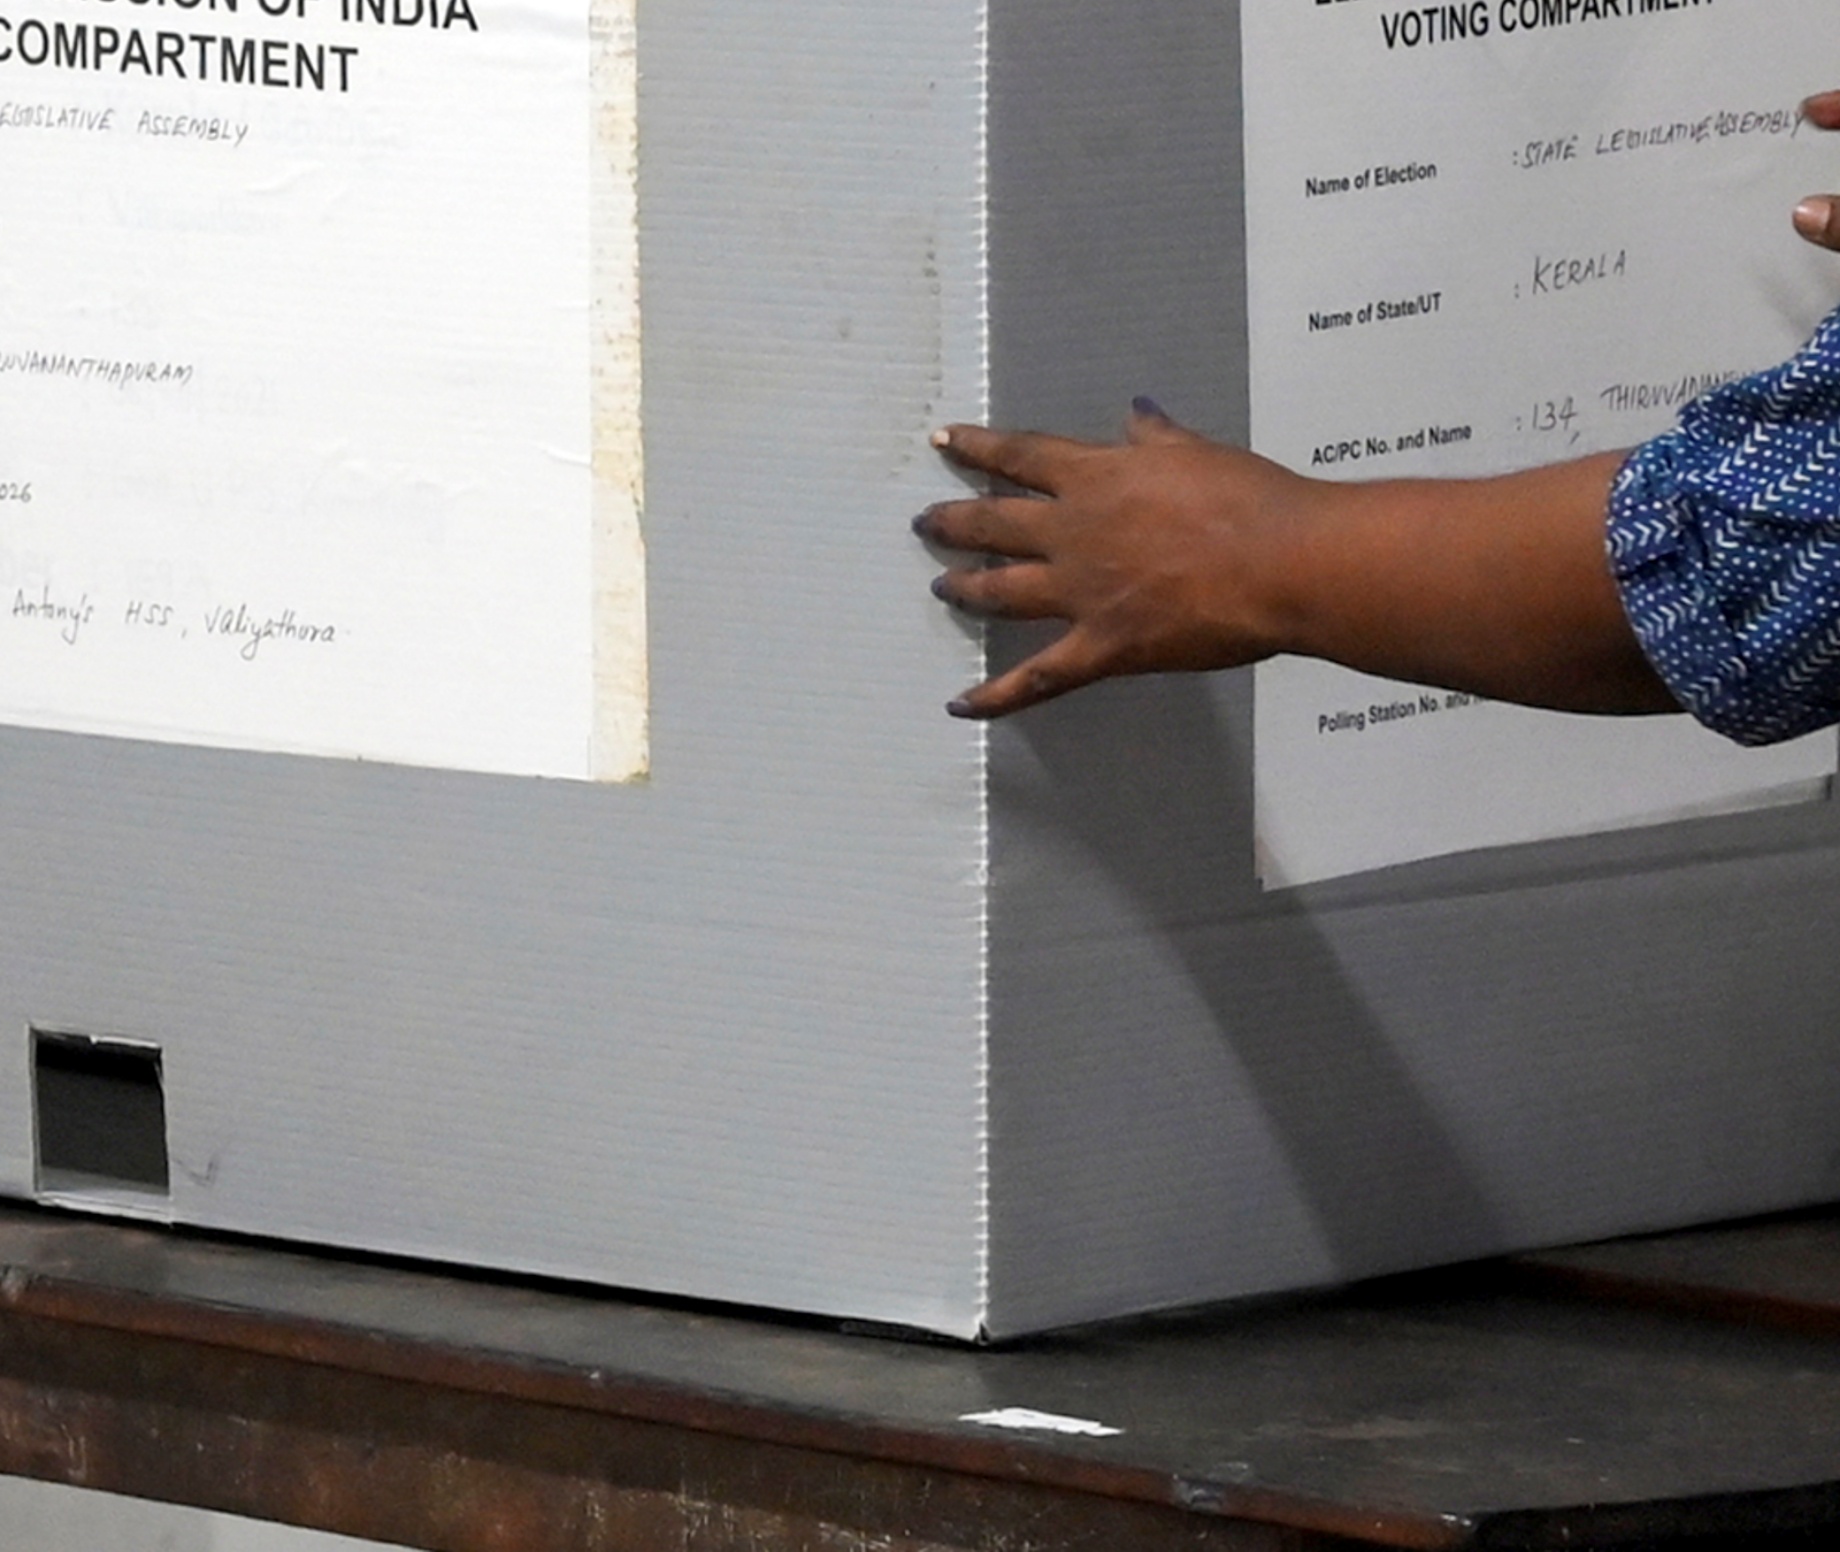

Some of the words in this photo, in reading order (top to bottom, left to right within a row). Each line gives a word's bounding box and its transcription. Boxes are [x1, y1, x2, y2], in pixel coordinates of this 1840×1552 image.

[1380, 0, 1490, 50] VOTING
[135, 108, 250, 150] ASSEMBLY
[1304, 176, 1351, 199] Name
[1353, 167, 1371, 191] of
[1373, 161, 1438, 188] Election
[1308, 310, 1354, 333] Name
[1356, 301, 1374, 325] of
[1375, 291, 1442, 322] State/UT
[1531, 248, 1627, 296] KERALA
[1311, 438, 1362, 467] AC/PC
[1365, 436, 1392, 458] No.
[1395, 427, 1426, 453] and
[1428, 424, 1473, 447] Name
[1531, 394, 1582, 447] 134,
[1317, 710, 1367, 735] Polling
[1367, 700, 1417, 725] Station
[1418, 693, 1442, 715] No.
